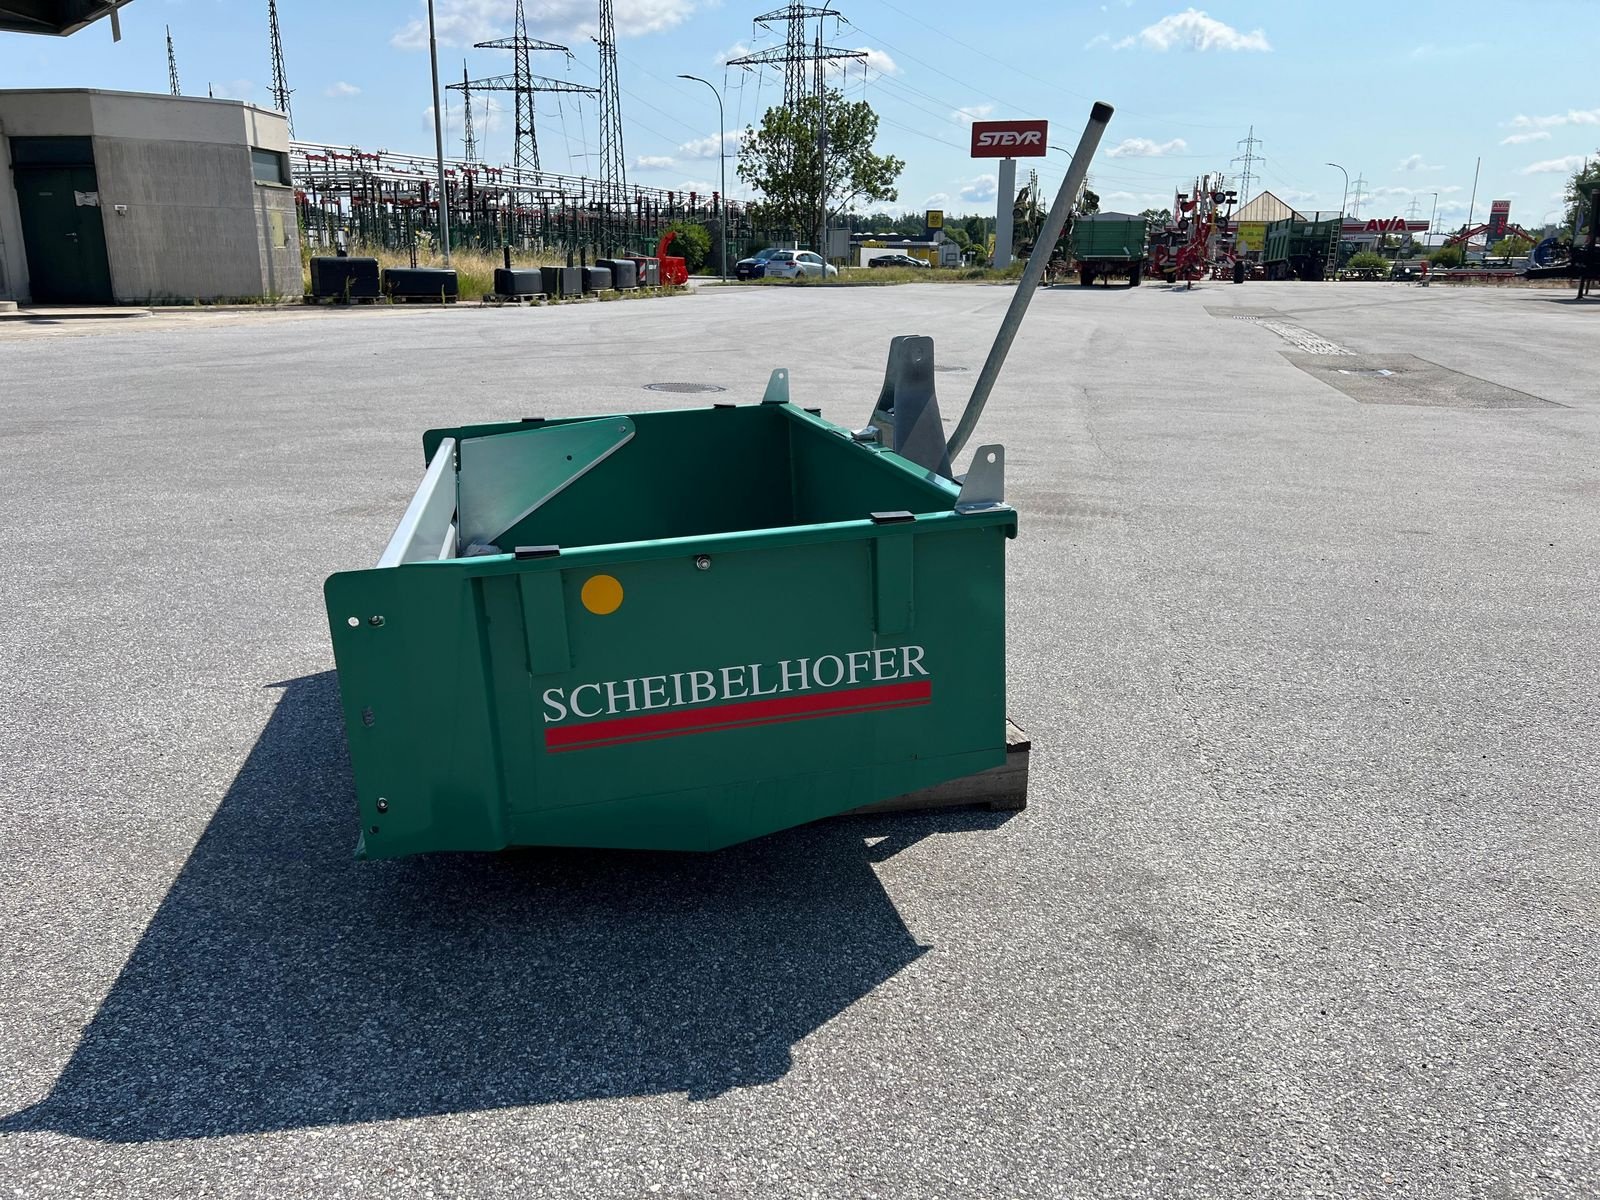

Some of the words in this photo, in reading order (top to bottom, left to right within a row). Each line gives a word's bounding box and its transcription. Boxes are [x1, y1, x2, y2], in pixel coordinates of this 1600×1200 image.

[977, 131, 1042, 146] STEYR
[1367, 217, 1408, 232] AVIA
[542, 645, 930, 722] SCHEIBELHOFER
